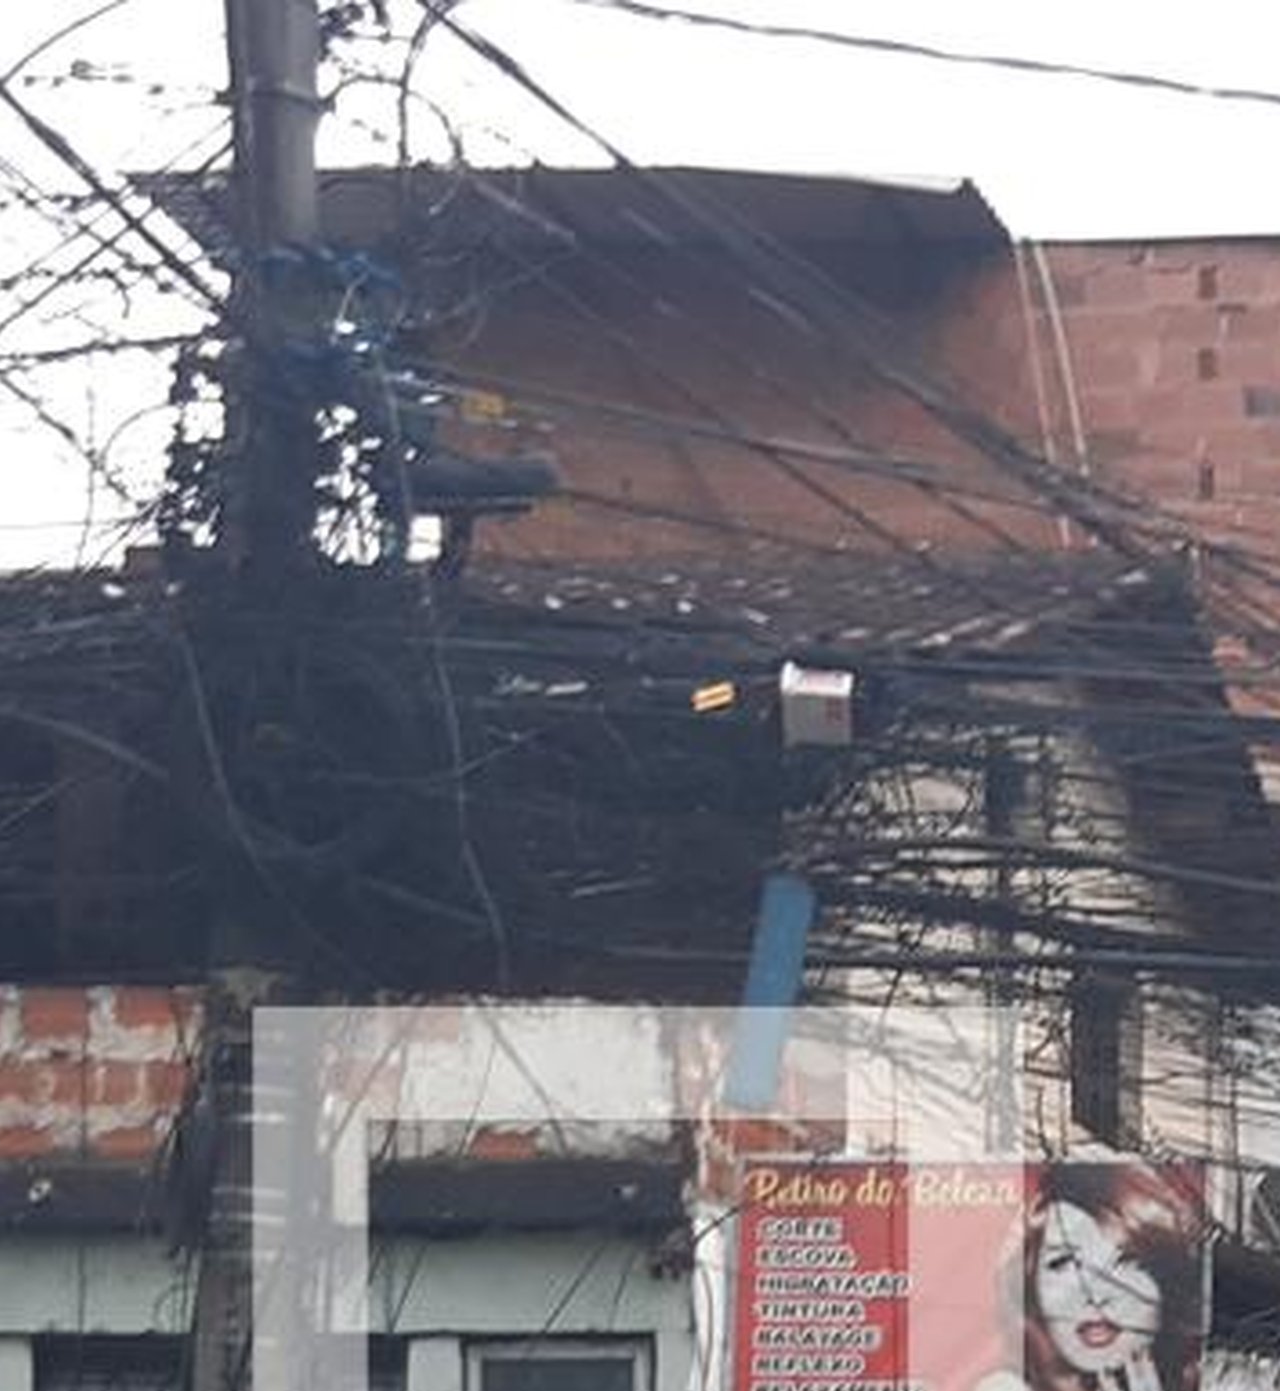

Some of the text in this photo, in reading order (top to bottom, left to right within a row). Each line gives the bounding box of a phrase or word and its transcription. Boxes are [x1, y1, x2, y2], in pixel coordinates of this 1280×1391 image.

[758, 1218, 840, 1239] CORTE
[757, 1247, 855, 1268] ESCOVA
[759, 1301, 864, 1321] TINTURA
[755, 1354, 864, 1374] REFLEXO
